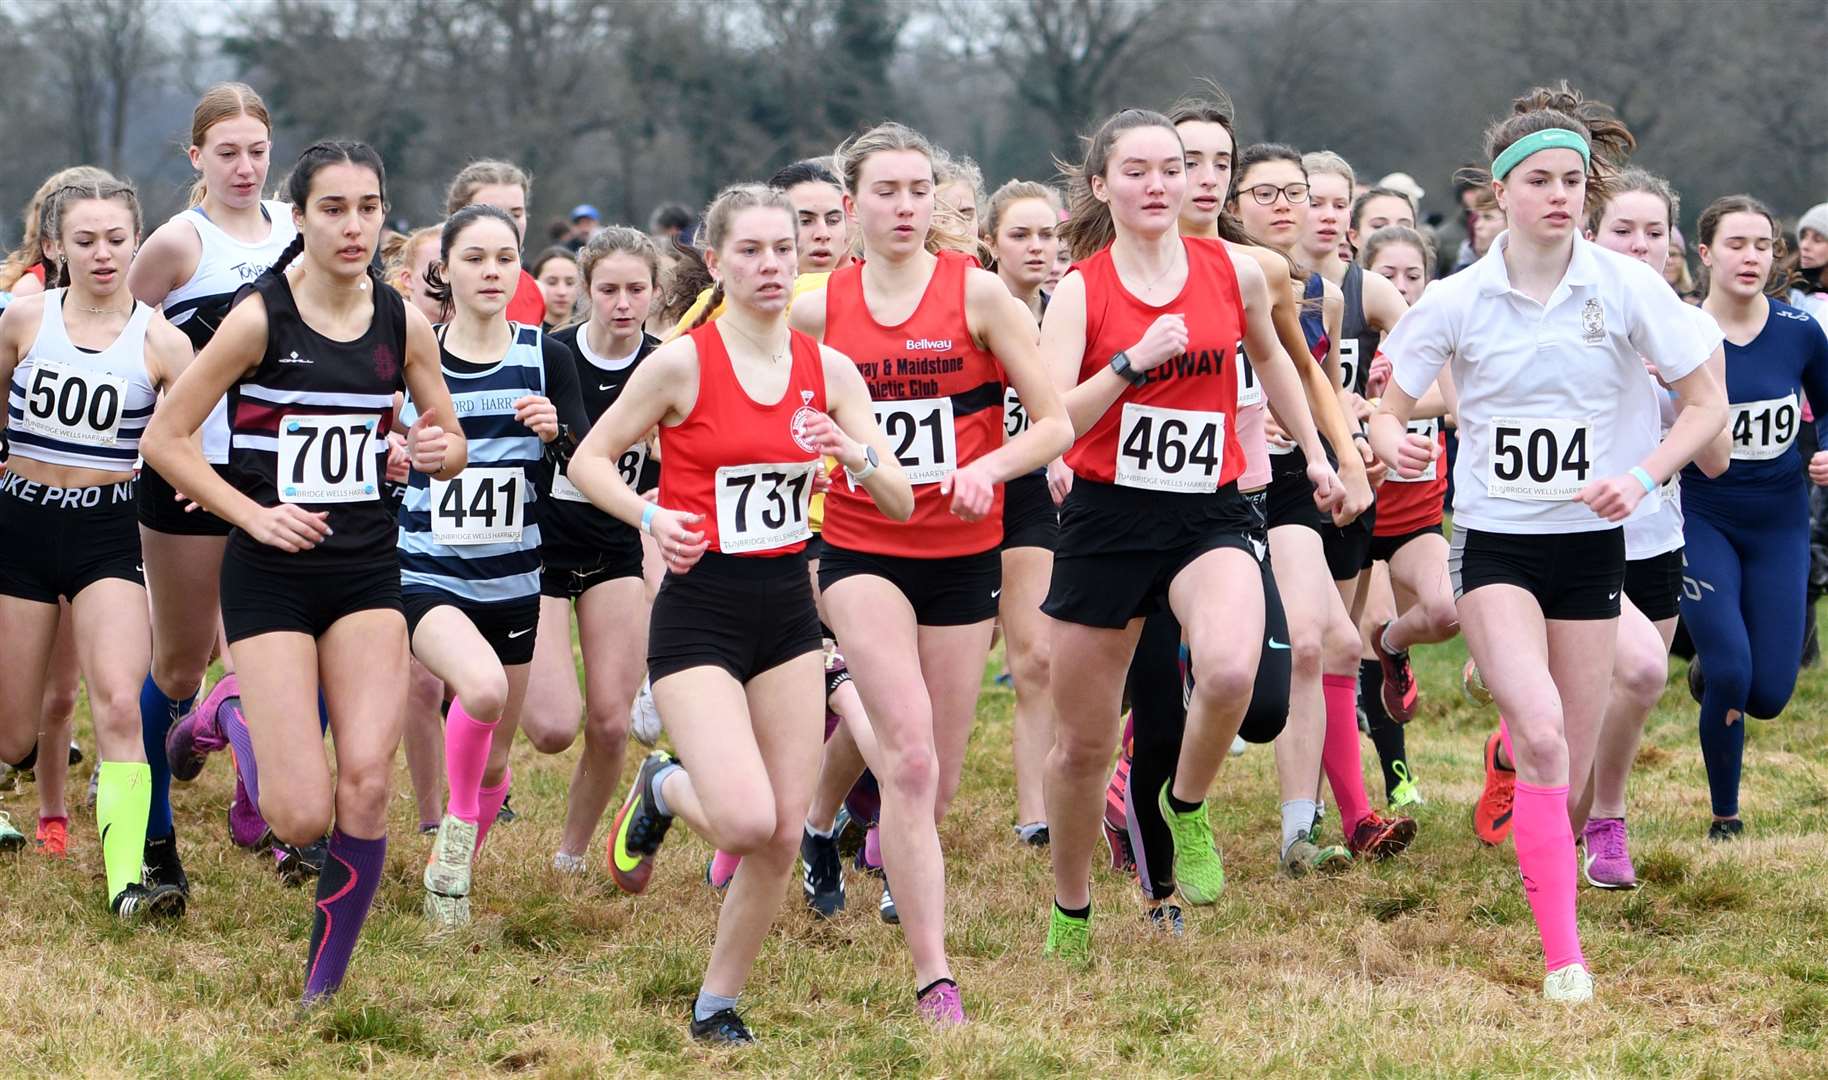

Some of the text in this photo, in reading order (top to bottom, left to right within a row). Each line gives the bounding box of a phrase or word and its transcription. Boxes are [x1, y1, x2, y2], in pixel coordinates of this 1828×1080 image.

[906, 339, 952, 351] Bellway
[856, 356, 963, 379] way & Maidstone
[1144, 348, 1225, 383] EDWAY
[29, 368, 118, 431] 500
[868, 379, 938, 398] hletic Club
[60, 429, 80, 439] WELLS
[875, 408, 945, 467] 21
[1732, 405, 1794, 446] 419
[287, 425, 373, 484] 707
[1122, 416, 1218, 476] 464
[1494, 427, 1590, 483] 504
[41, 486, 101, 508] PRO
[112, 480, 133, 504] NI
[326, 489, 347, 497] WELLS
[1160, 478, 1181, 487] WELLS
[1534, 487, 1558, 495] WELLS
[439, 477, 516, 528] 441
[726, 472, 808, 533] 731
